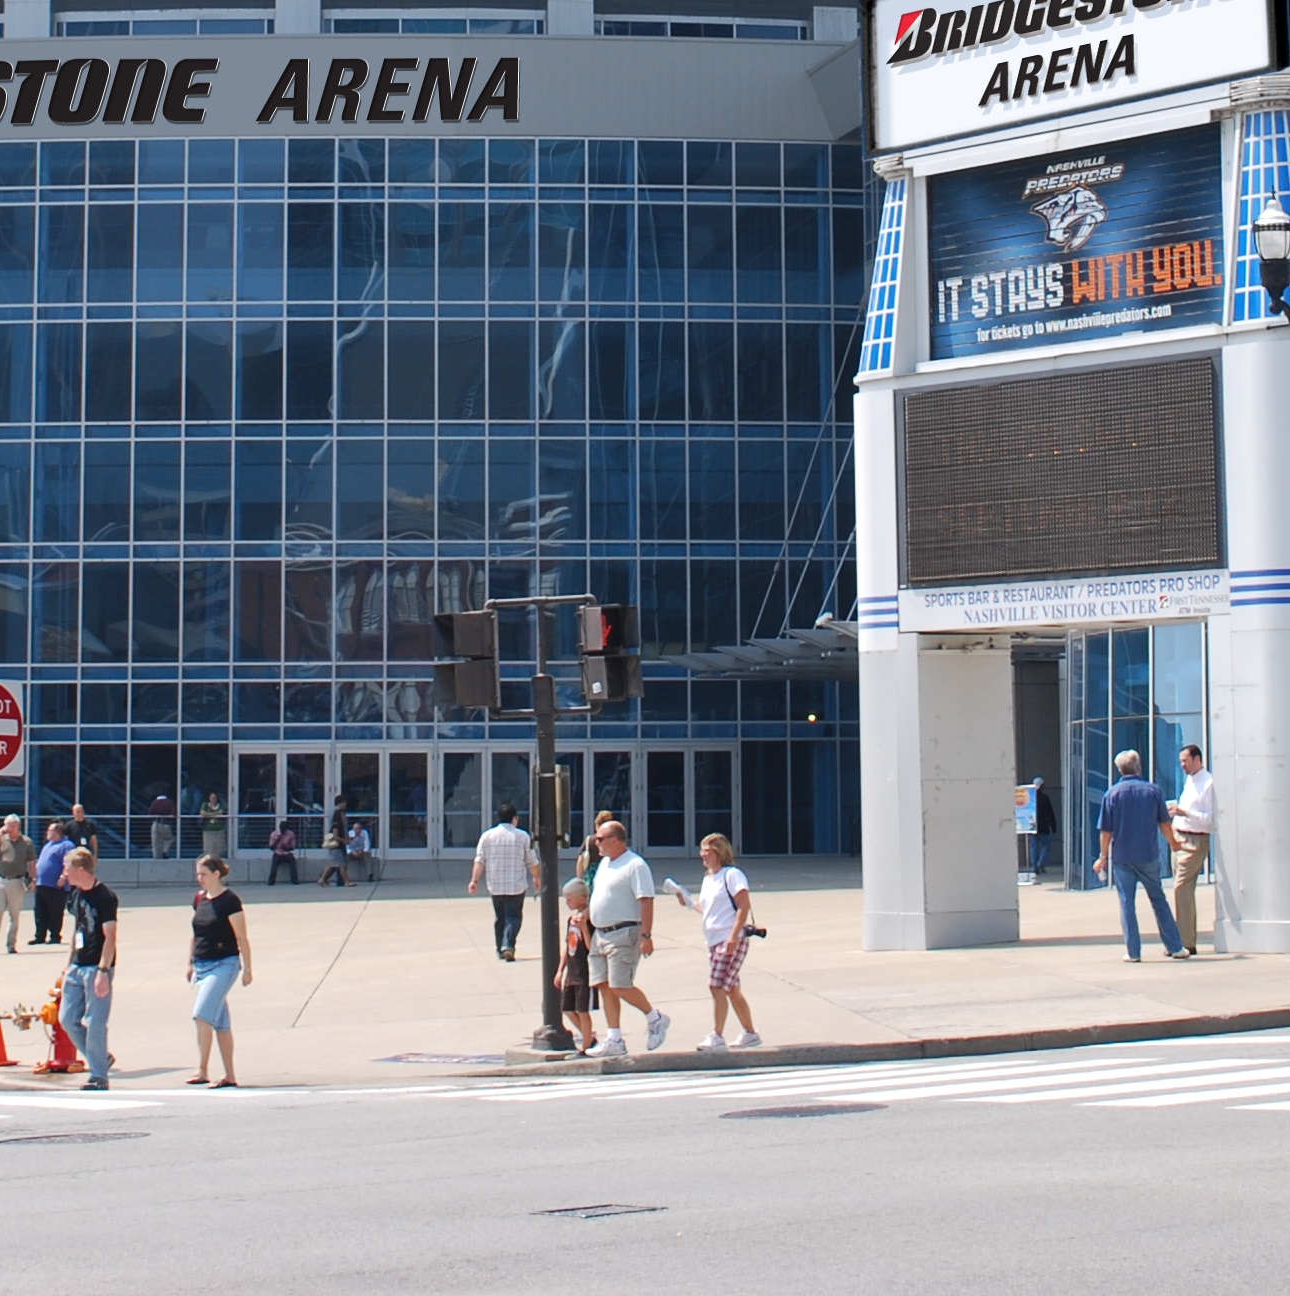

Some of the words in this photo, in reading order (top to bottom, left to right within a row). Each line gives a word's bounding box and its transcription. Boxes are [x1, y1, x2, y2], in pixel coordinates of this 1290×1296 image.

[978, 34, 1136, 107] ARENA
[256, 57, 521, 123] ARENA
[1023, 164, 1125, 197] PREDATORS
[1046, 155, 1106, 174] NASHVILLE
[938, 277, 963, 323] IT
[971, 263, 1064, 319] STAYS
[1072, 250, 1145, 304] WITH
[1153, 239, 1223, 293] YOU.
[977, 327, 991, 342] for
[992, 323, 1021, 341] tickets
[1022, 325, 1034, 339] go
[1035, 320, 1045, 334] to
[1045, 304, 1172, 333] www.nashvillepredators.com
[924, 592, 965, 608] SPORTS
[968, 589, 989, 604] BAR
[993, 589, 1001, 603] &
[1003, 585, 1075, 603] RESTAURANT
[1087, 579, 1156, 599] PREDATORS
[1159, 577, 1185, 593] PRO
[1188, 574, 1220, 591] SHOP
[964, 605, 1039, 624] NASHVILLE
[1042, 600, 1097, 620] VISITOR
[1100, 598, 1157, 616] CENTER
